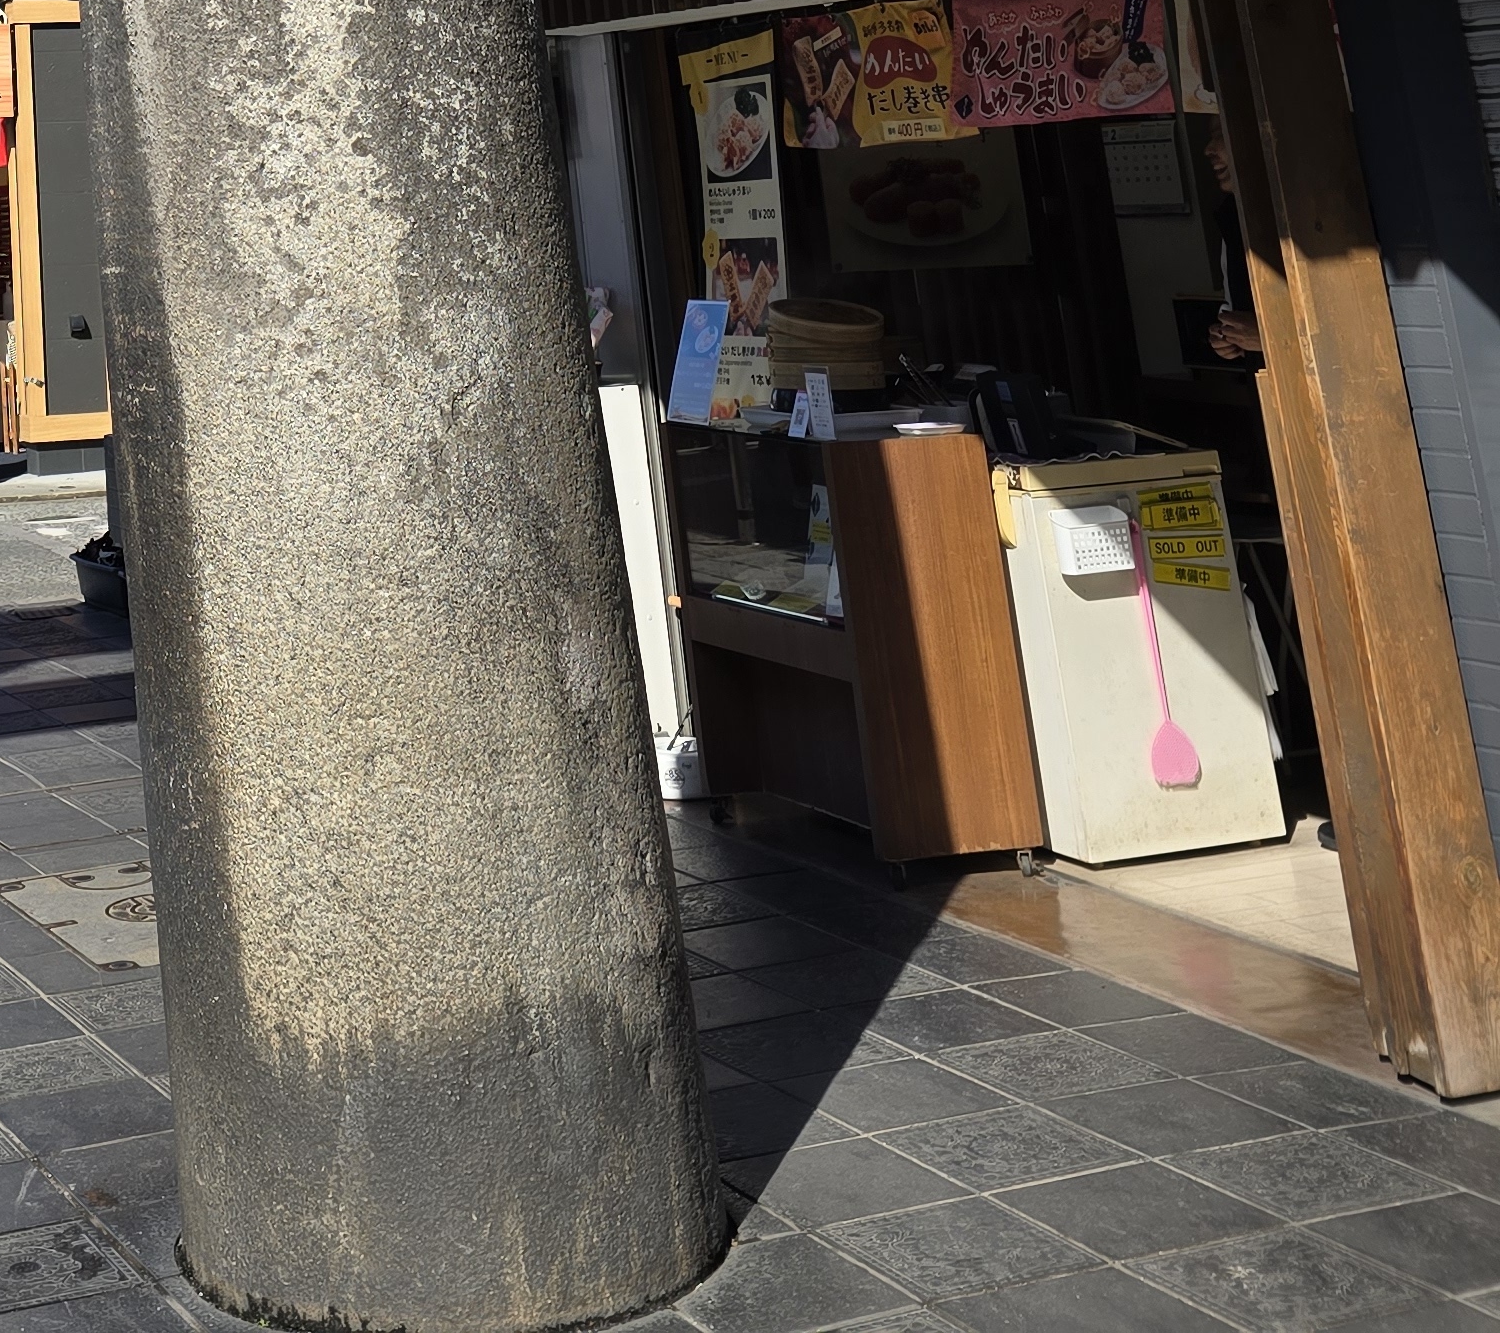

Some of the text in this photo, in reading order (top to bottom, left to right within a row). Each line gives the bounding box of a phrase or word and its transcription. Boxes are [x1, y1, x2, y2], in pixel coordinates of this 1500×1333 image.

[865, 48, 930, 76] めんたい
[962, 25, 1068, 79] めんたい
[868, 82, 951, 116] だし巻き串
[979, 71, 1086, 119] しゅうまい
[1162, 505, 1200, 524] 準備中
[1155, 540, 1219, 554] SOLD OUT
[1175, 567, 1211, 585] 準備中
